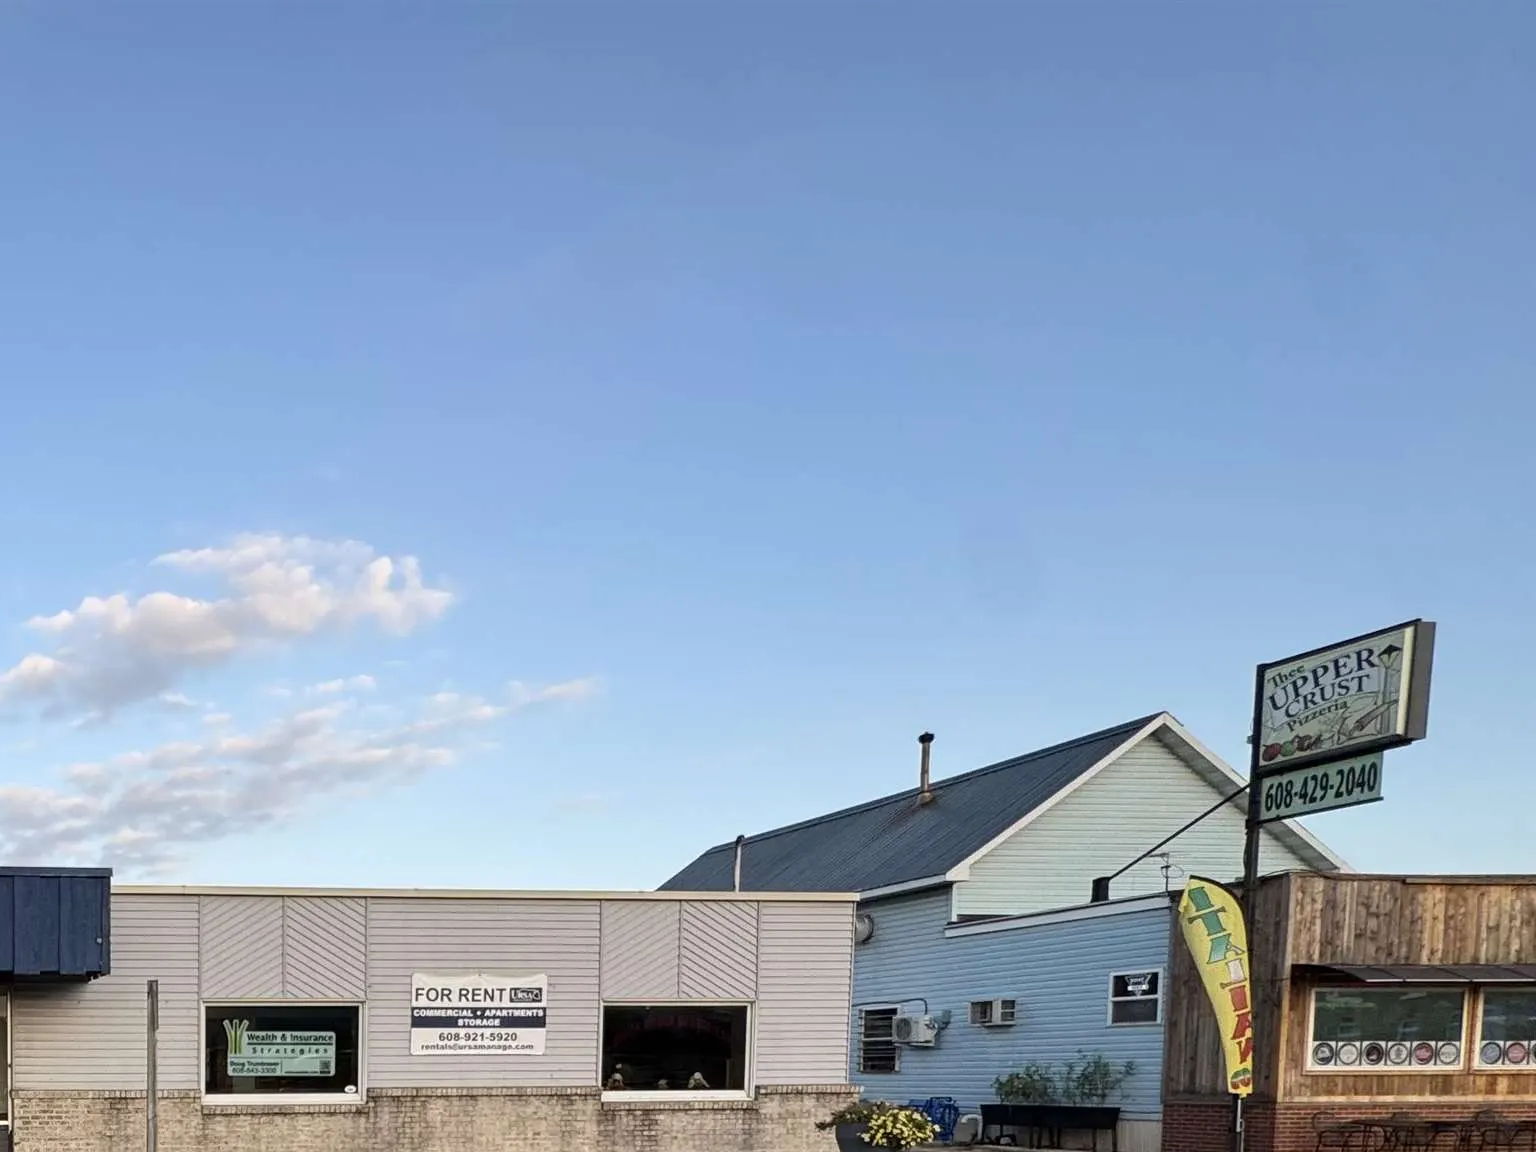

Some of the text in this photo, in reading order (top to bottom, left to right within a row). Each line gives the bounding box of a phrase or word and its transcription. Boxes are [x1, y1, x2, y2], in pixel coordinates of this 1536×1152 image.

[1267, 665, 1305, 688] Thee
[1267, 648, 1380, 711] UPPER
[1284, 674, 1370, 718] CRUST
[1287, 701, 1350, 732] Pizzeria
[1265, 761, 1379, 812] 608-429-2040
[415, 987, 453, 1003] FOR
[458, 987, 507, 1003] RENT
[413, 1009, 544, 1017] COMMERCIAL APARTMENTS
[457, 1018, 501, 1026] STORAGE
[246, 1032, 334, 1042] Wealth & Insurance
[438, 1032, 518, 1042] 608-921-5920
[251, 1046, 328, 1055] Strategies
